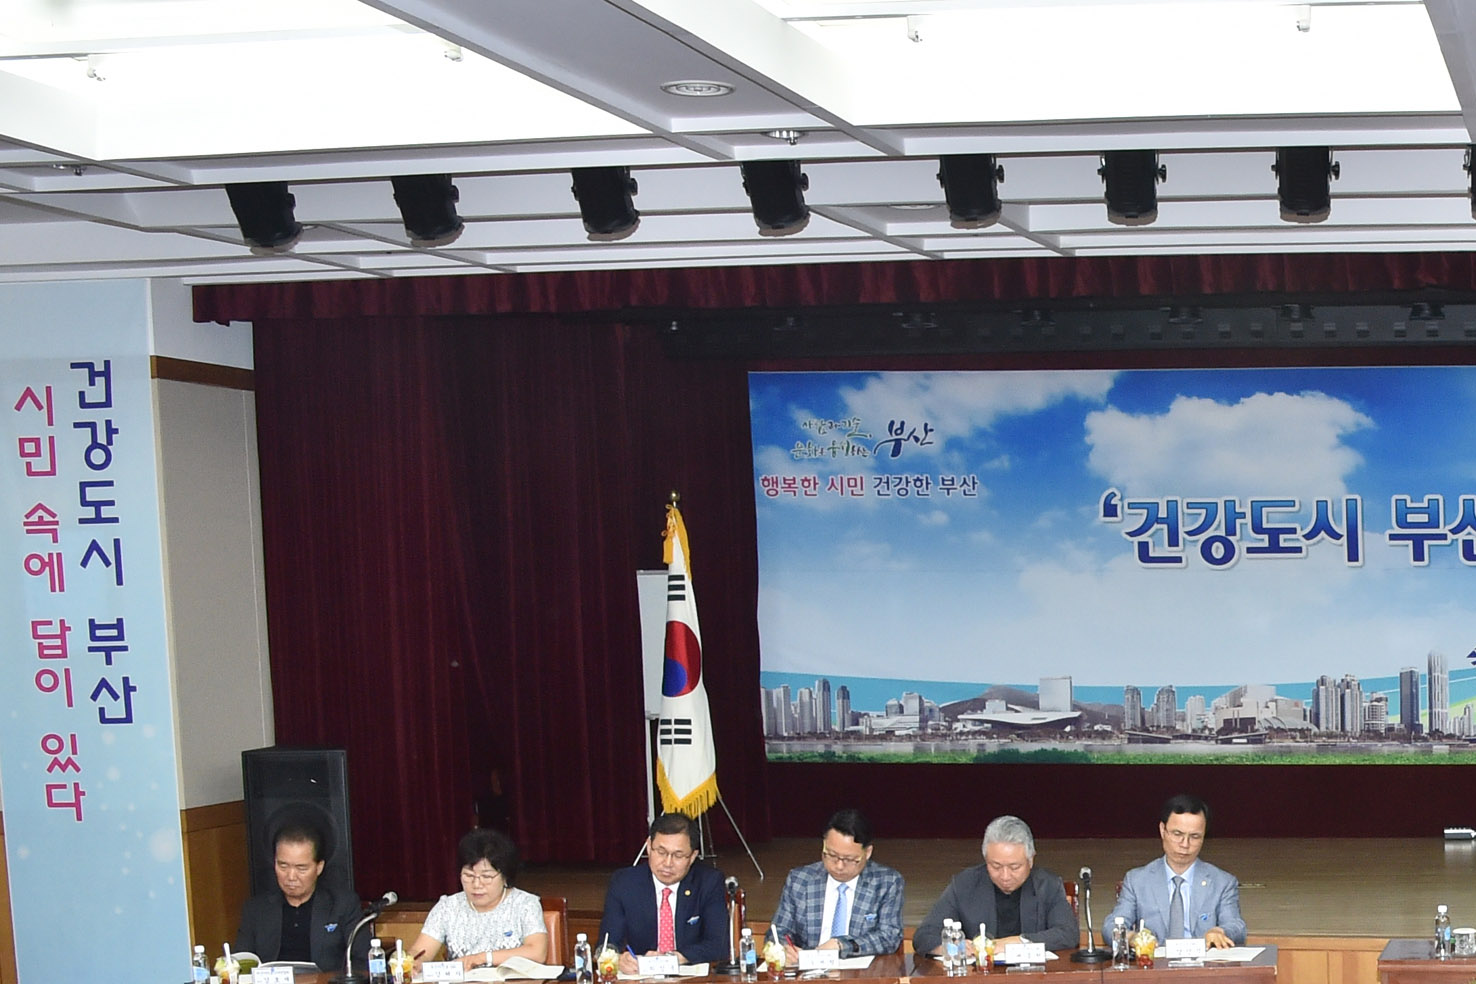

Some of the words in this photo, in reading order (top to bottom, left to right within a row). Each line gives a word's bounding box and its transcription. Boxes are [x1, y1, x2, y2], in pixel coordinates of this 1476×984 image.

[14, 385, 57, 478] 시민
[70, 360, 126, 587] 건강도시
[873, 419, 935, 458] 부산
[760, 475, 819, 497] 행복한
[827, 475, 865, 497] 시민
[873, 475, 932, 497] 건강한
[939, 475, 979, 497] 부산
[23, 502, 66, 594] 속에
[31, 618, 74, 710] 답이
[87, 617, 137, 725] 부산
[40, 732, 86, 822] 있다
